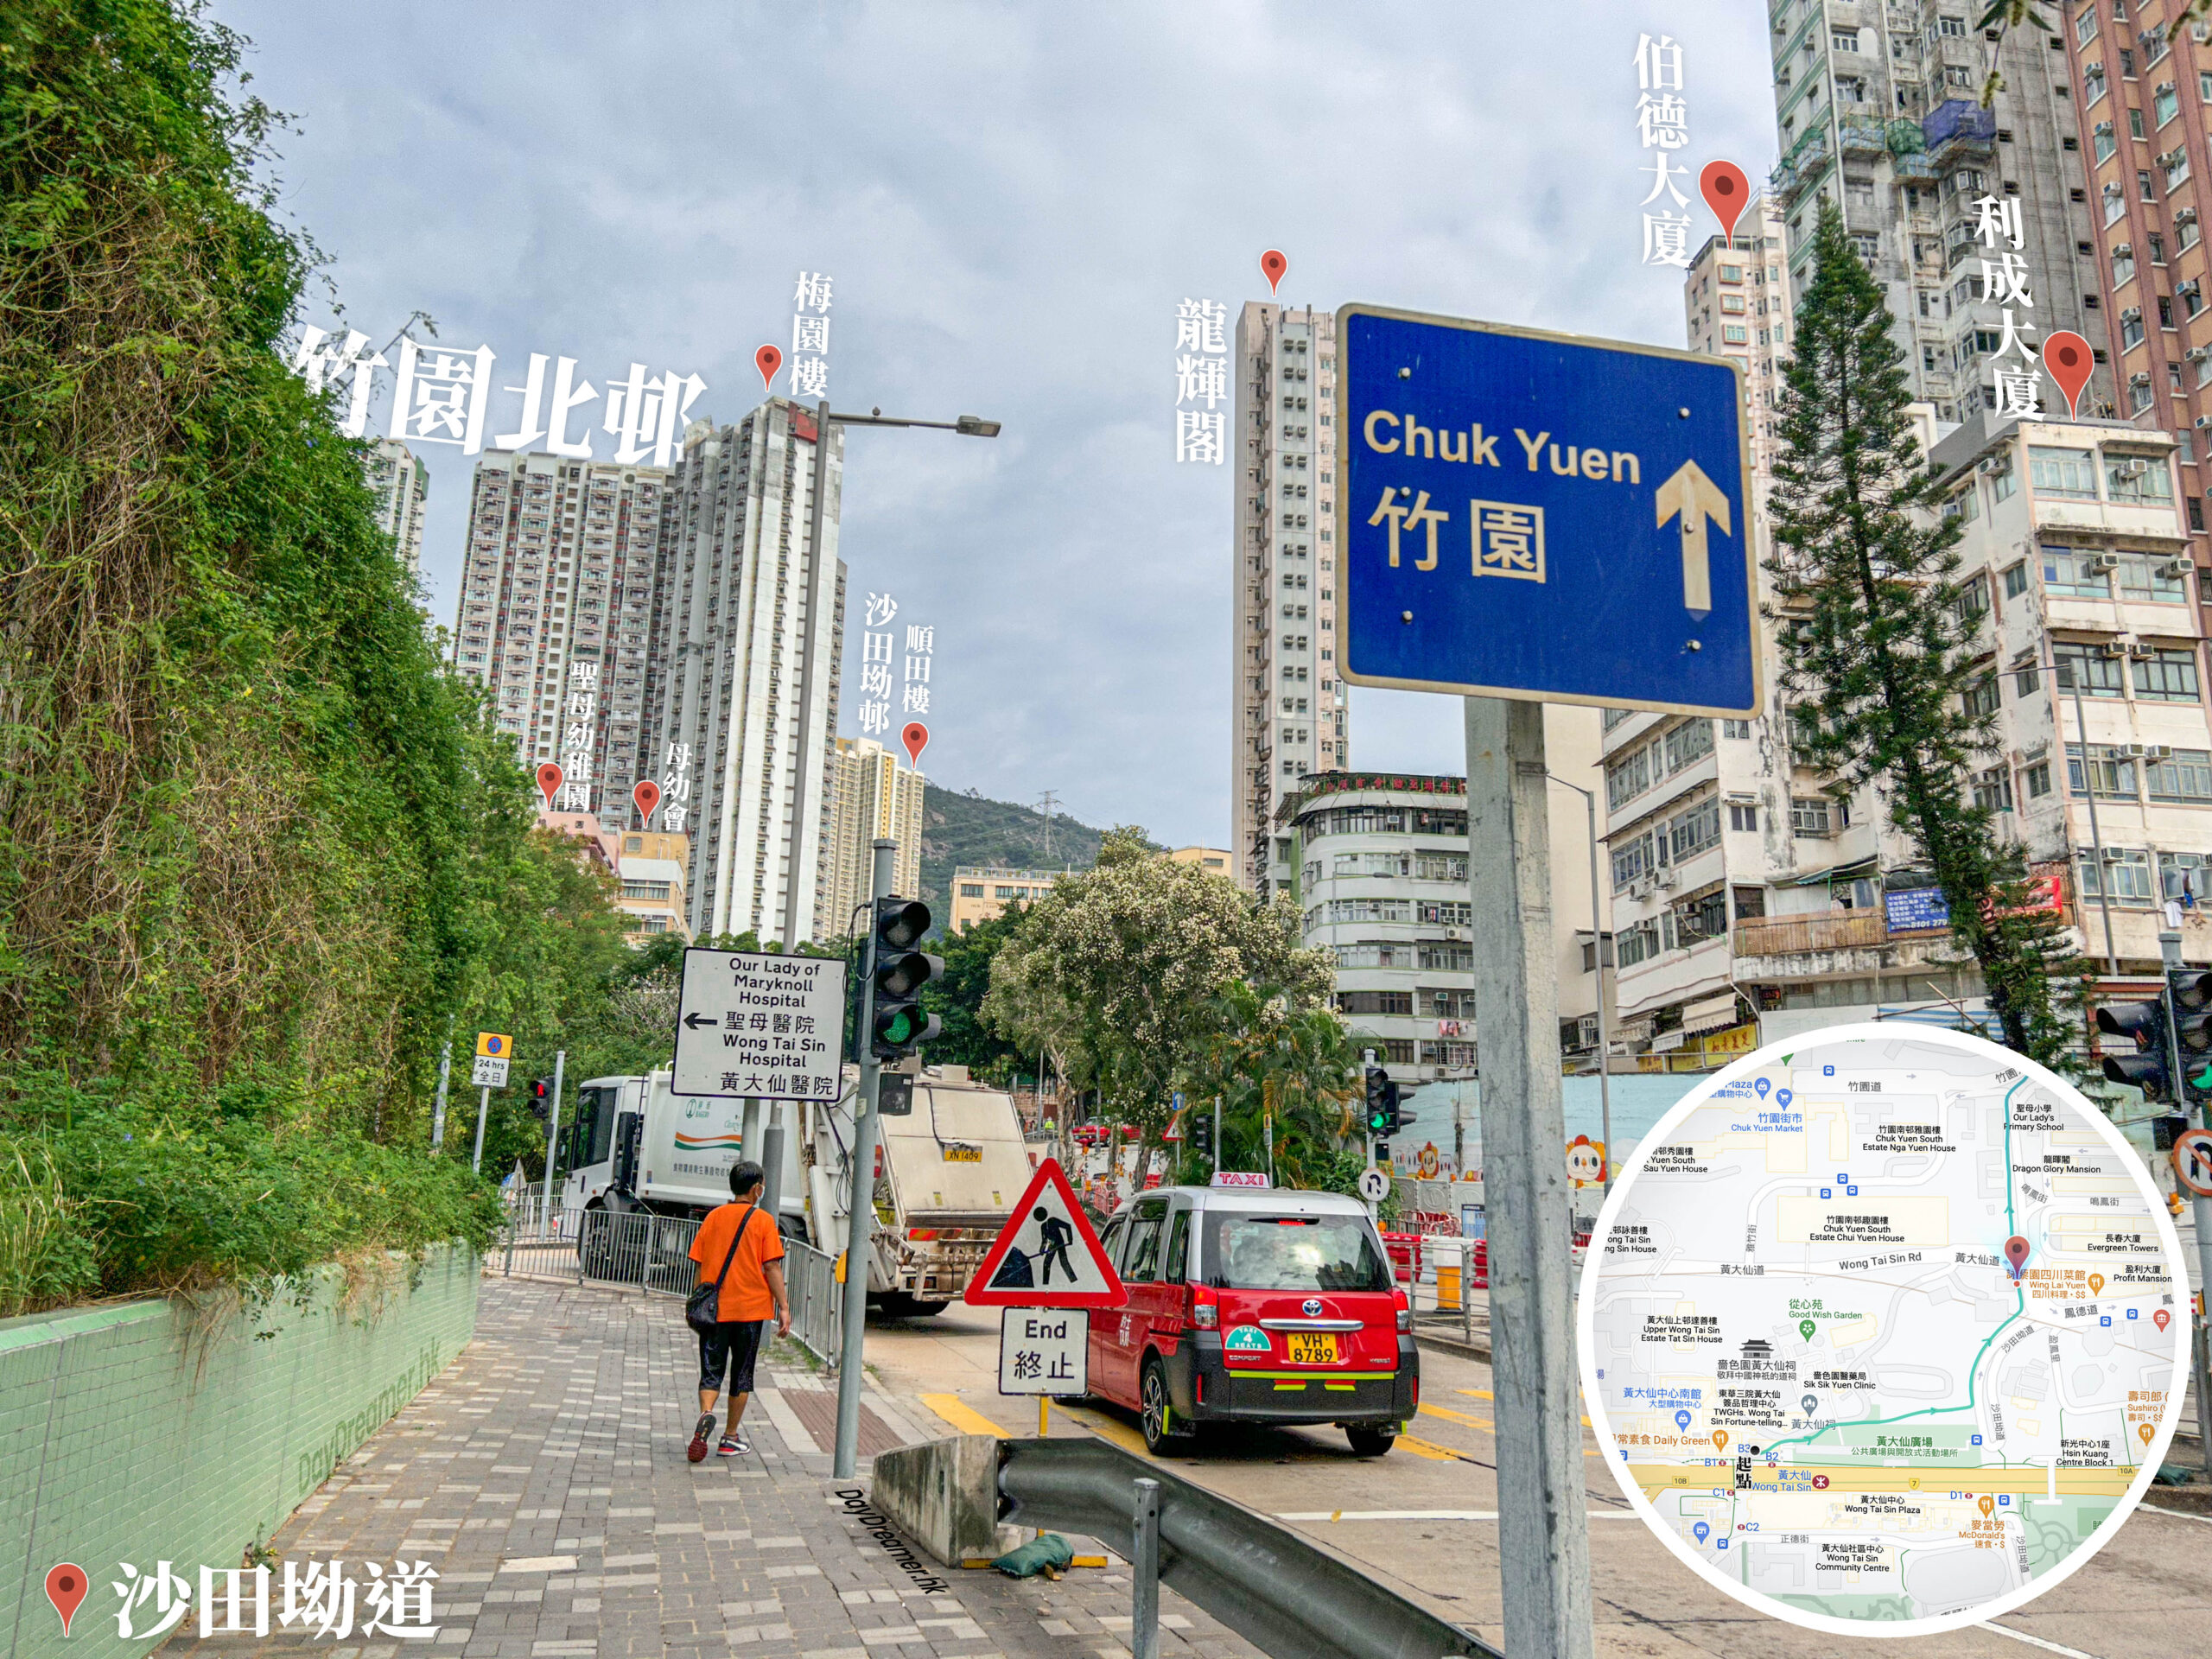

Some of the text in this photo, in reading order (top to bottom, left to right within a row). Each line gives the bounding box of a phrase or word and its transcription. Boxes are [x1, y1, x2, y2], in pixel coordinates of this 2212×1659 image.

[1363, 410, 1641, 485] Chuk Yuen
[1368, 486, 1547, 583] 竹園
[1910, 918, 1948, 929] 8101 279
[729, 957, 821, 976] Our Lady of
[734, 975, 813, 992] Maryknoll
[740, 991, 806, 1008] Hospital
[725, 1011, 815, 1034] 聖母醫院
[723, 1034, 826, 1052] Wong Tai Sin
[493, 1060, 505, 1070] hrs
[740, 1052, 806, 1068] Hospital
[479, 1071, 501, 1084] 全日
[720, 1071, 833, 1096] 黃大仙醫院
[949, 1151, 979, 1160] XN 1409
[1219, 1173, 1264, 1185] TAXI
[1026, 1319, 1066, 1338] End
[1243, 1333, 1253, 1343] 4
[1302, 1334, 1323, 1347] VH
[1294, 1348, 1333, 1362] 8789
[1014, 1351, 1075, 1380] 終止
